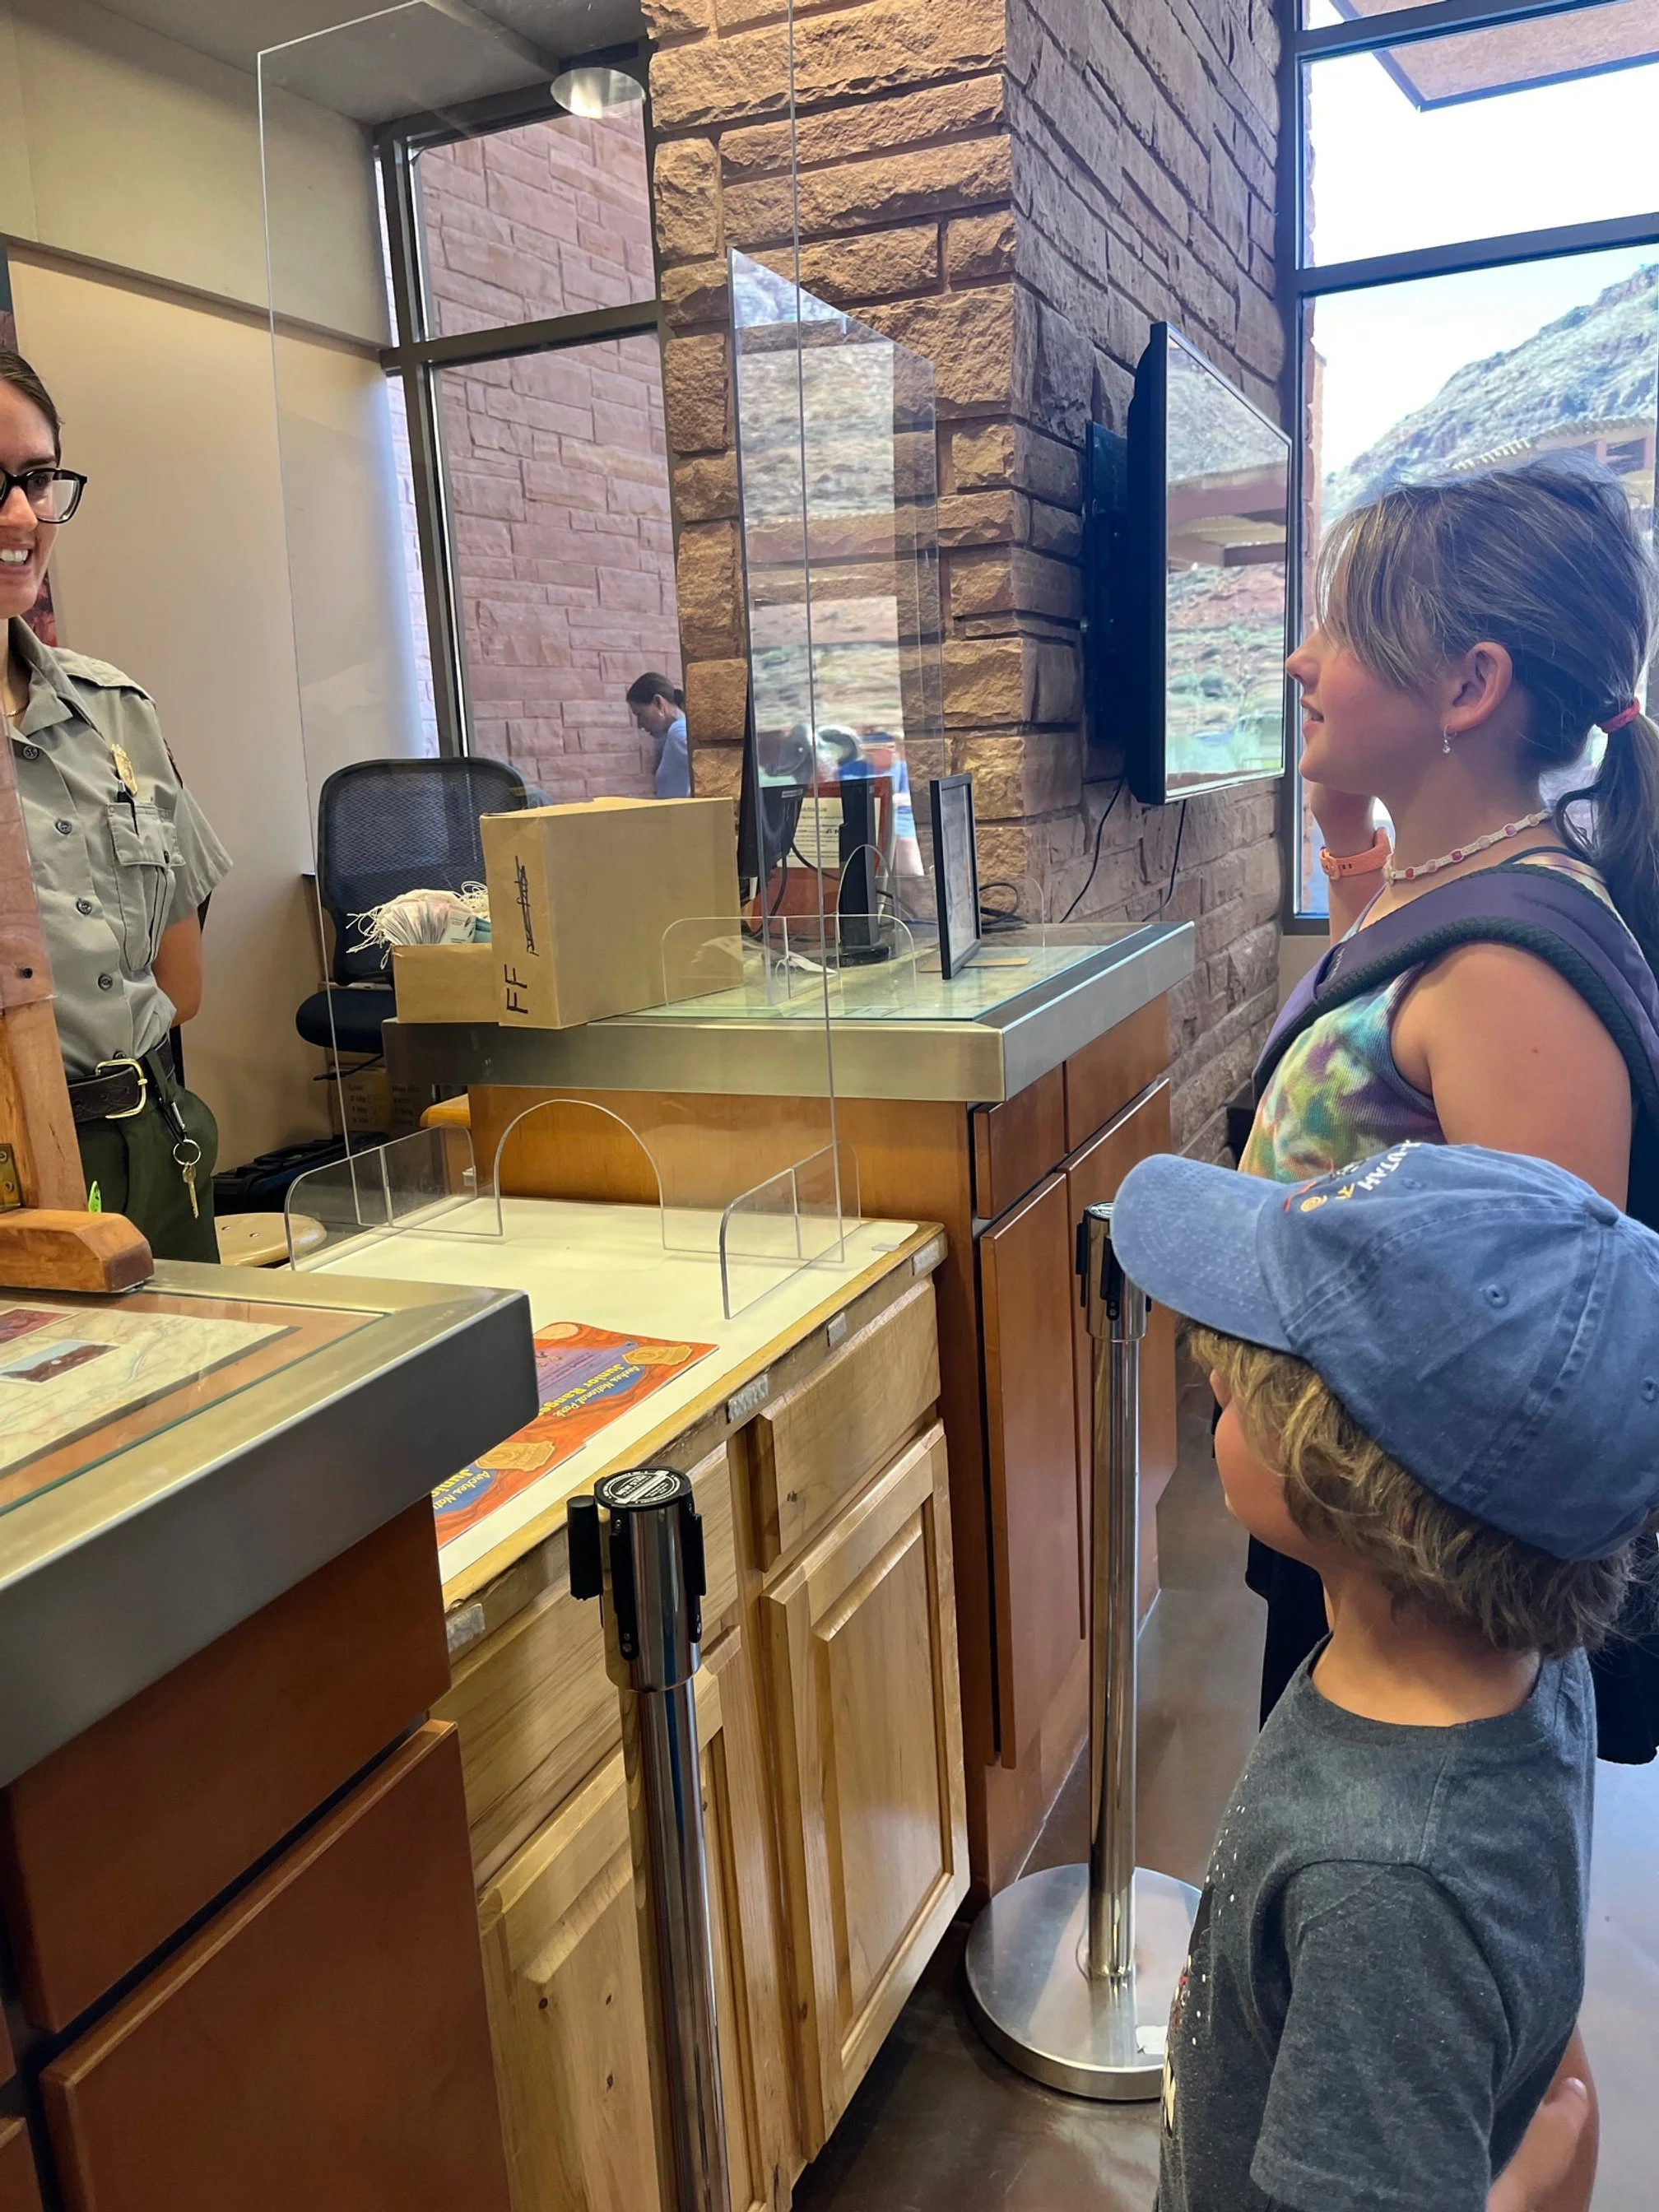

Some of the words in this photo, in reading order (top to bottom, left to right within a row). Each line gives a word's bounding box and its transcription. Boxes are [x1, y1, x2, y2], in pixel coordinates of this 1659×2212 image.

[1356, 1151, 1408, 1192] UTAH
[583, 1364, 625, 1387] Junior
[610, 1365, 640, 1382] Arches
[576, 1382, 615, 1405] National
[553, 1402, 580, 1417] Park
[431, 1469, 473, 1498] Junio
[452, 1470, 490, 1494] Arches
